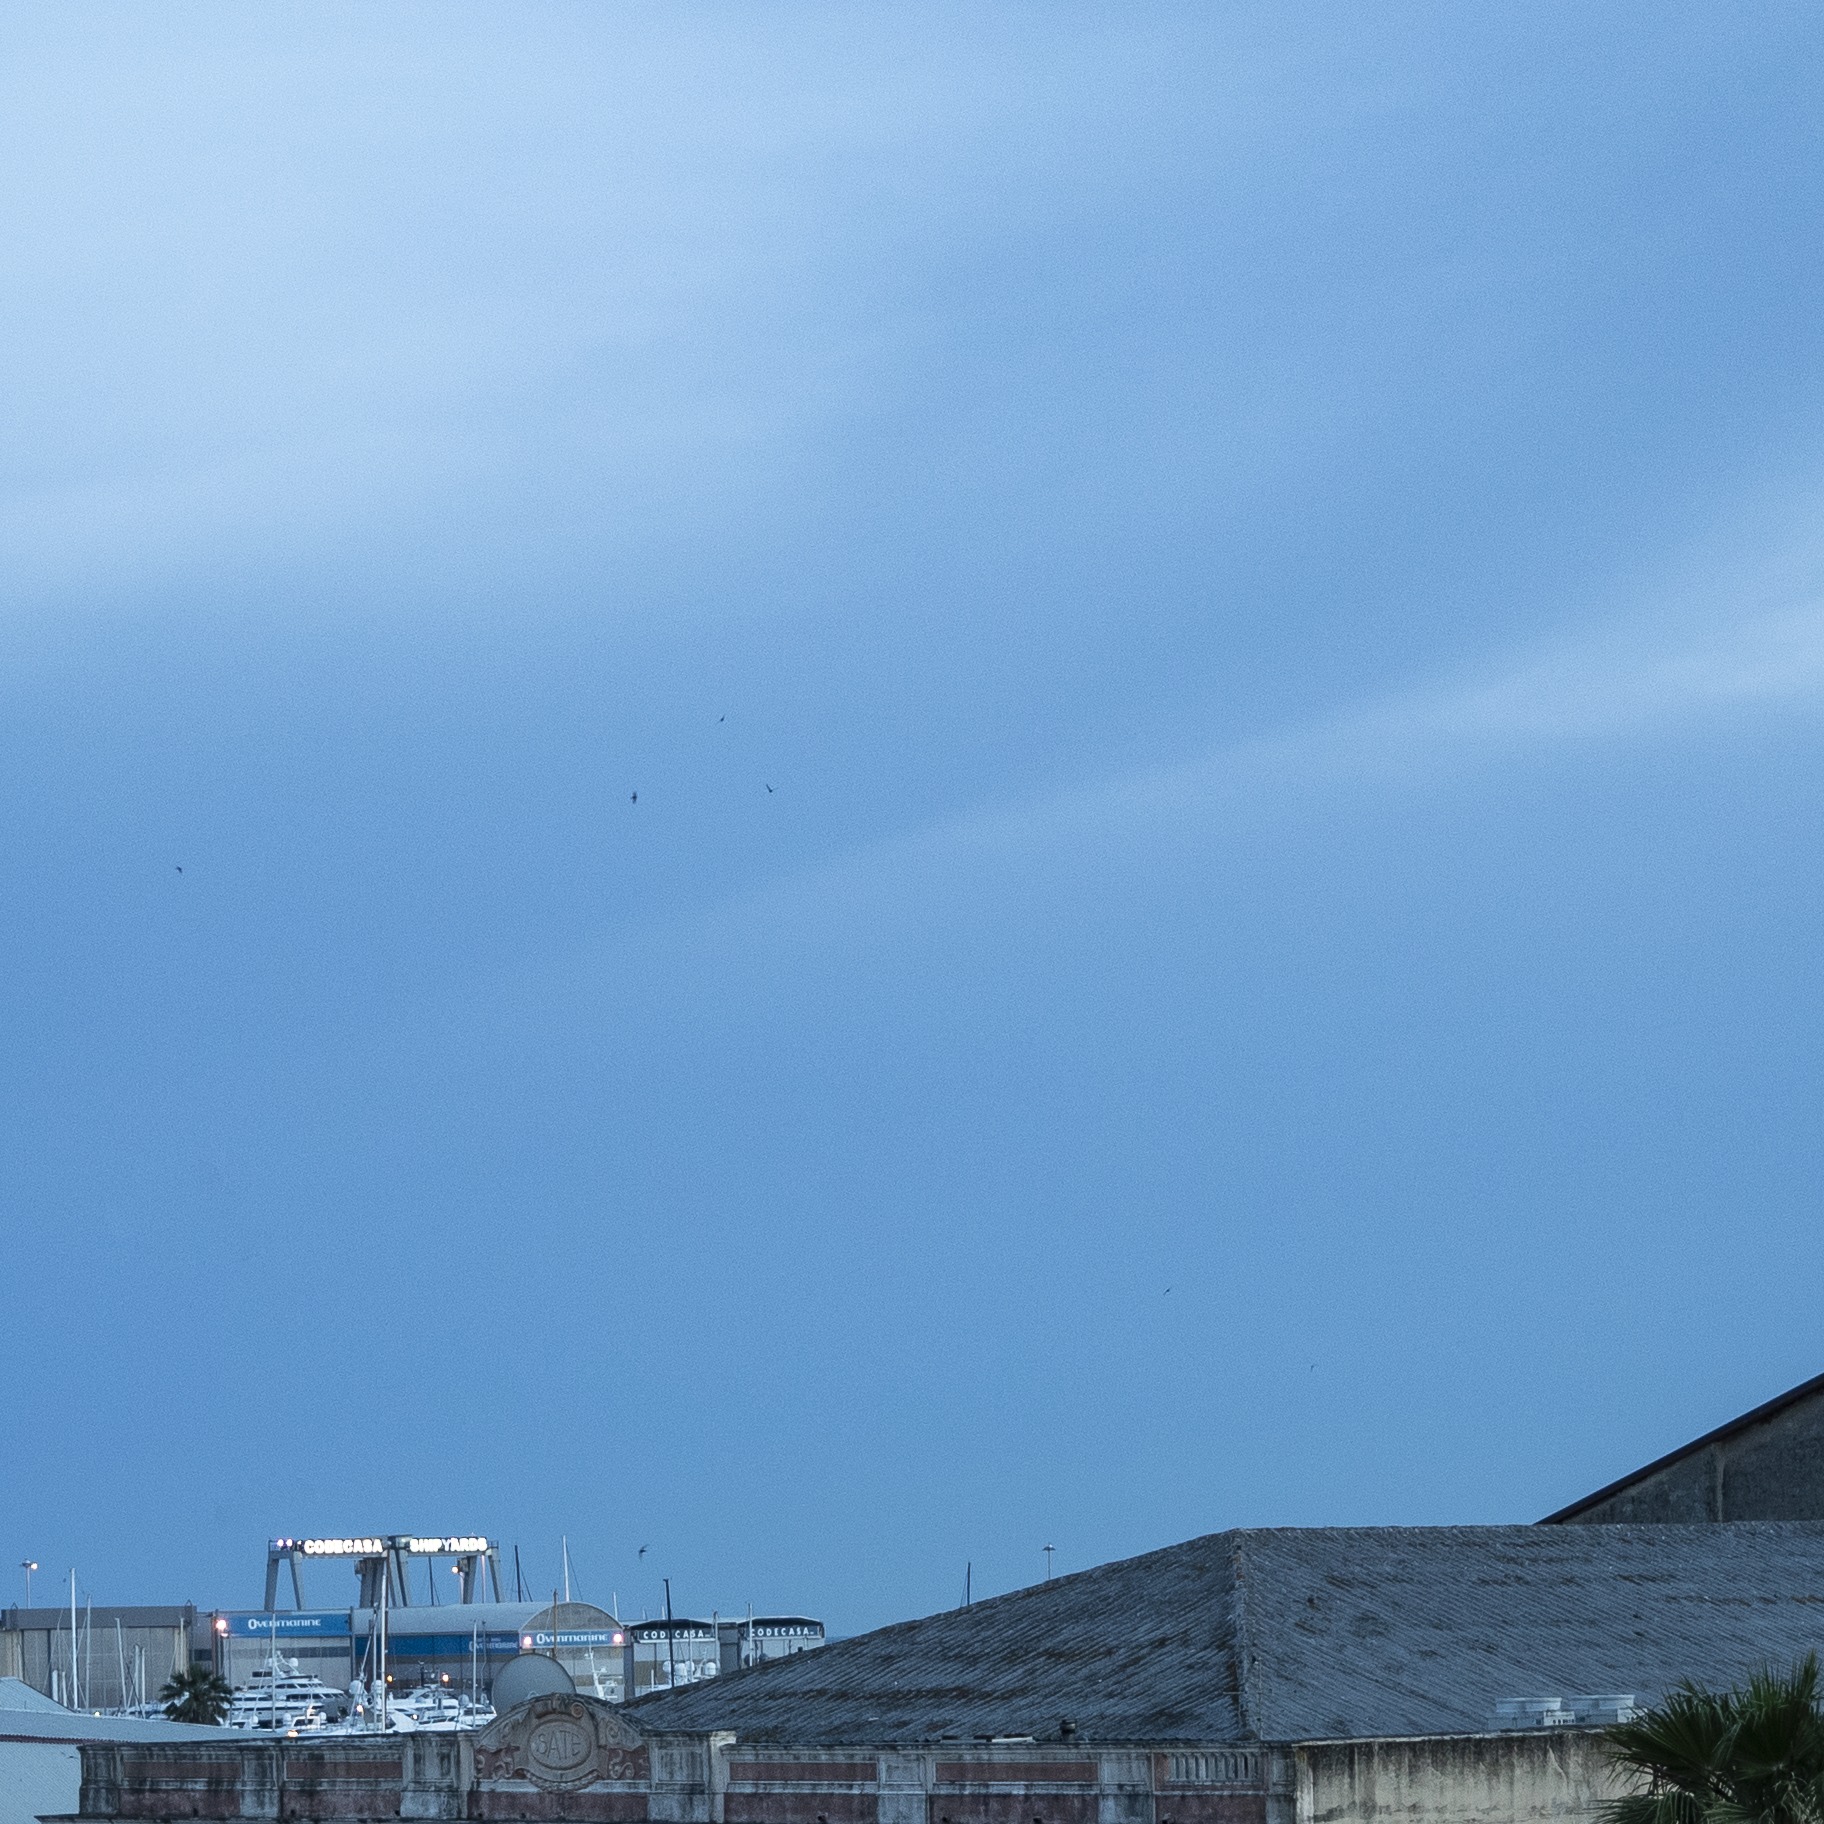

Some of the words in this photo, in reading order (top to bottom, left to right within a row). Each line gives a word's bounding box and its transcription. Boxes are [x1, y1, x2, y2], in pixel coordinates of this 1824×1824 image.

[303, 1539, 383, 1554] CODECASA
[409, 1537, 488, 1552] SHIPYARDS
[643, 1629, 704, 1639] CODCASA
